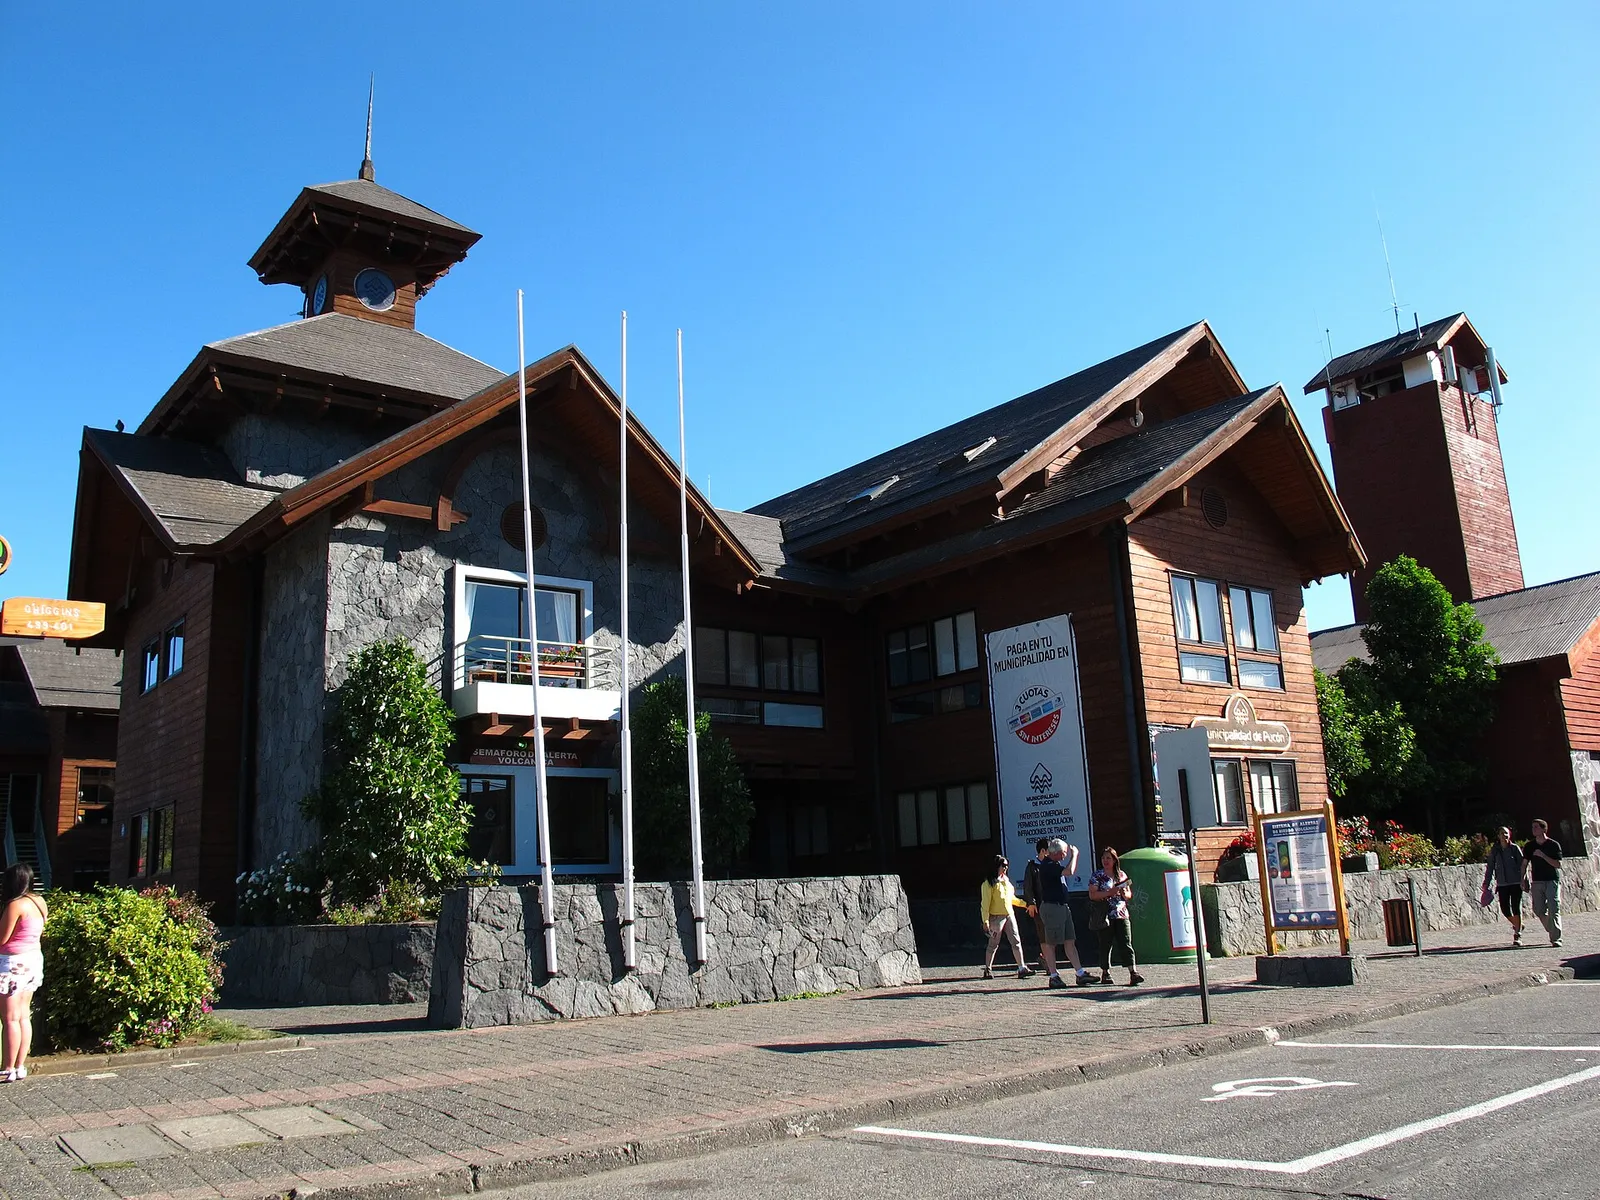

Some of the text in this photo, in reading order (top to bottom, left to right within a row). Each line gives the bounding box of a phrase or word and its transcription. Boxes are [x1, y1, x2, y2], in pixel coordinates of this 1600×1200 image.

[1006, 636, 1053, 657] PAGA EN TU
[994, 646, 1069, 674] MUNICIPALIDAD EN
[1014, 704, 1022, 712] 3
[1019, 687, 1049, 705] CUOTAS
[1018, 729, 1029, 741] SIN
[1031, 713, 1060, 743] INTERESES
[1207, 729, 1285, 742] unicipalidad de Pucón
[473, 748, 527, 758] SEMAFORO
[499, 757, 554, 766] VOLCANA
[1026, 793, 1060, 801] MUNICIPALIDAD
